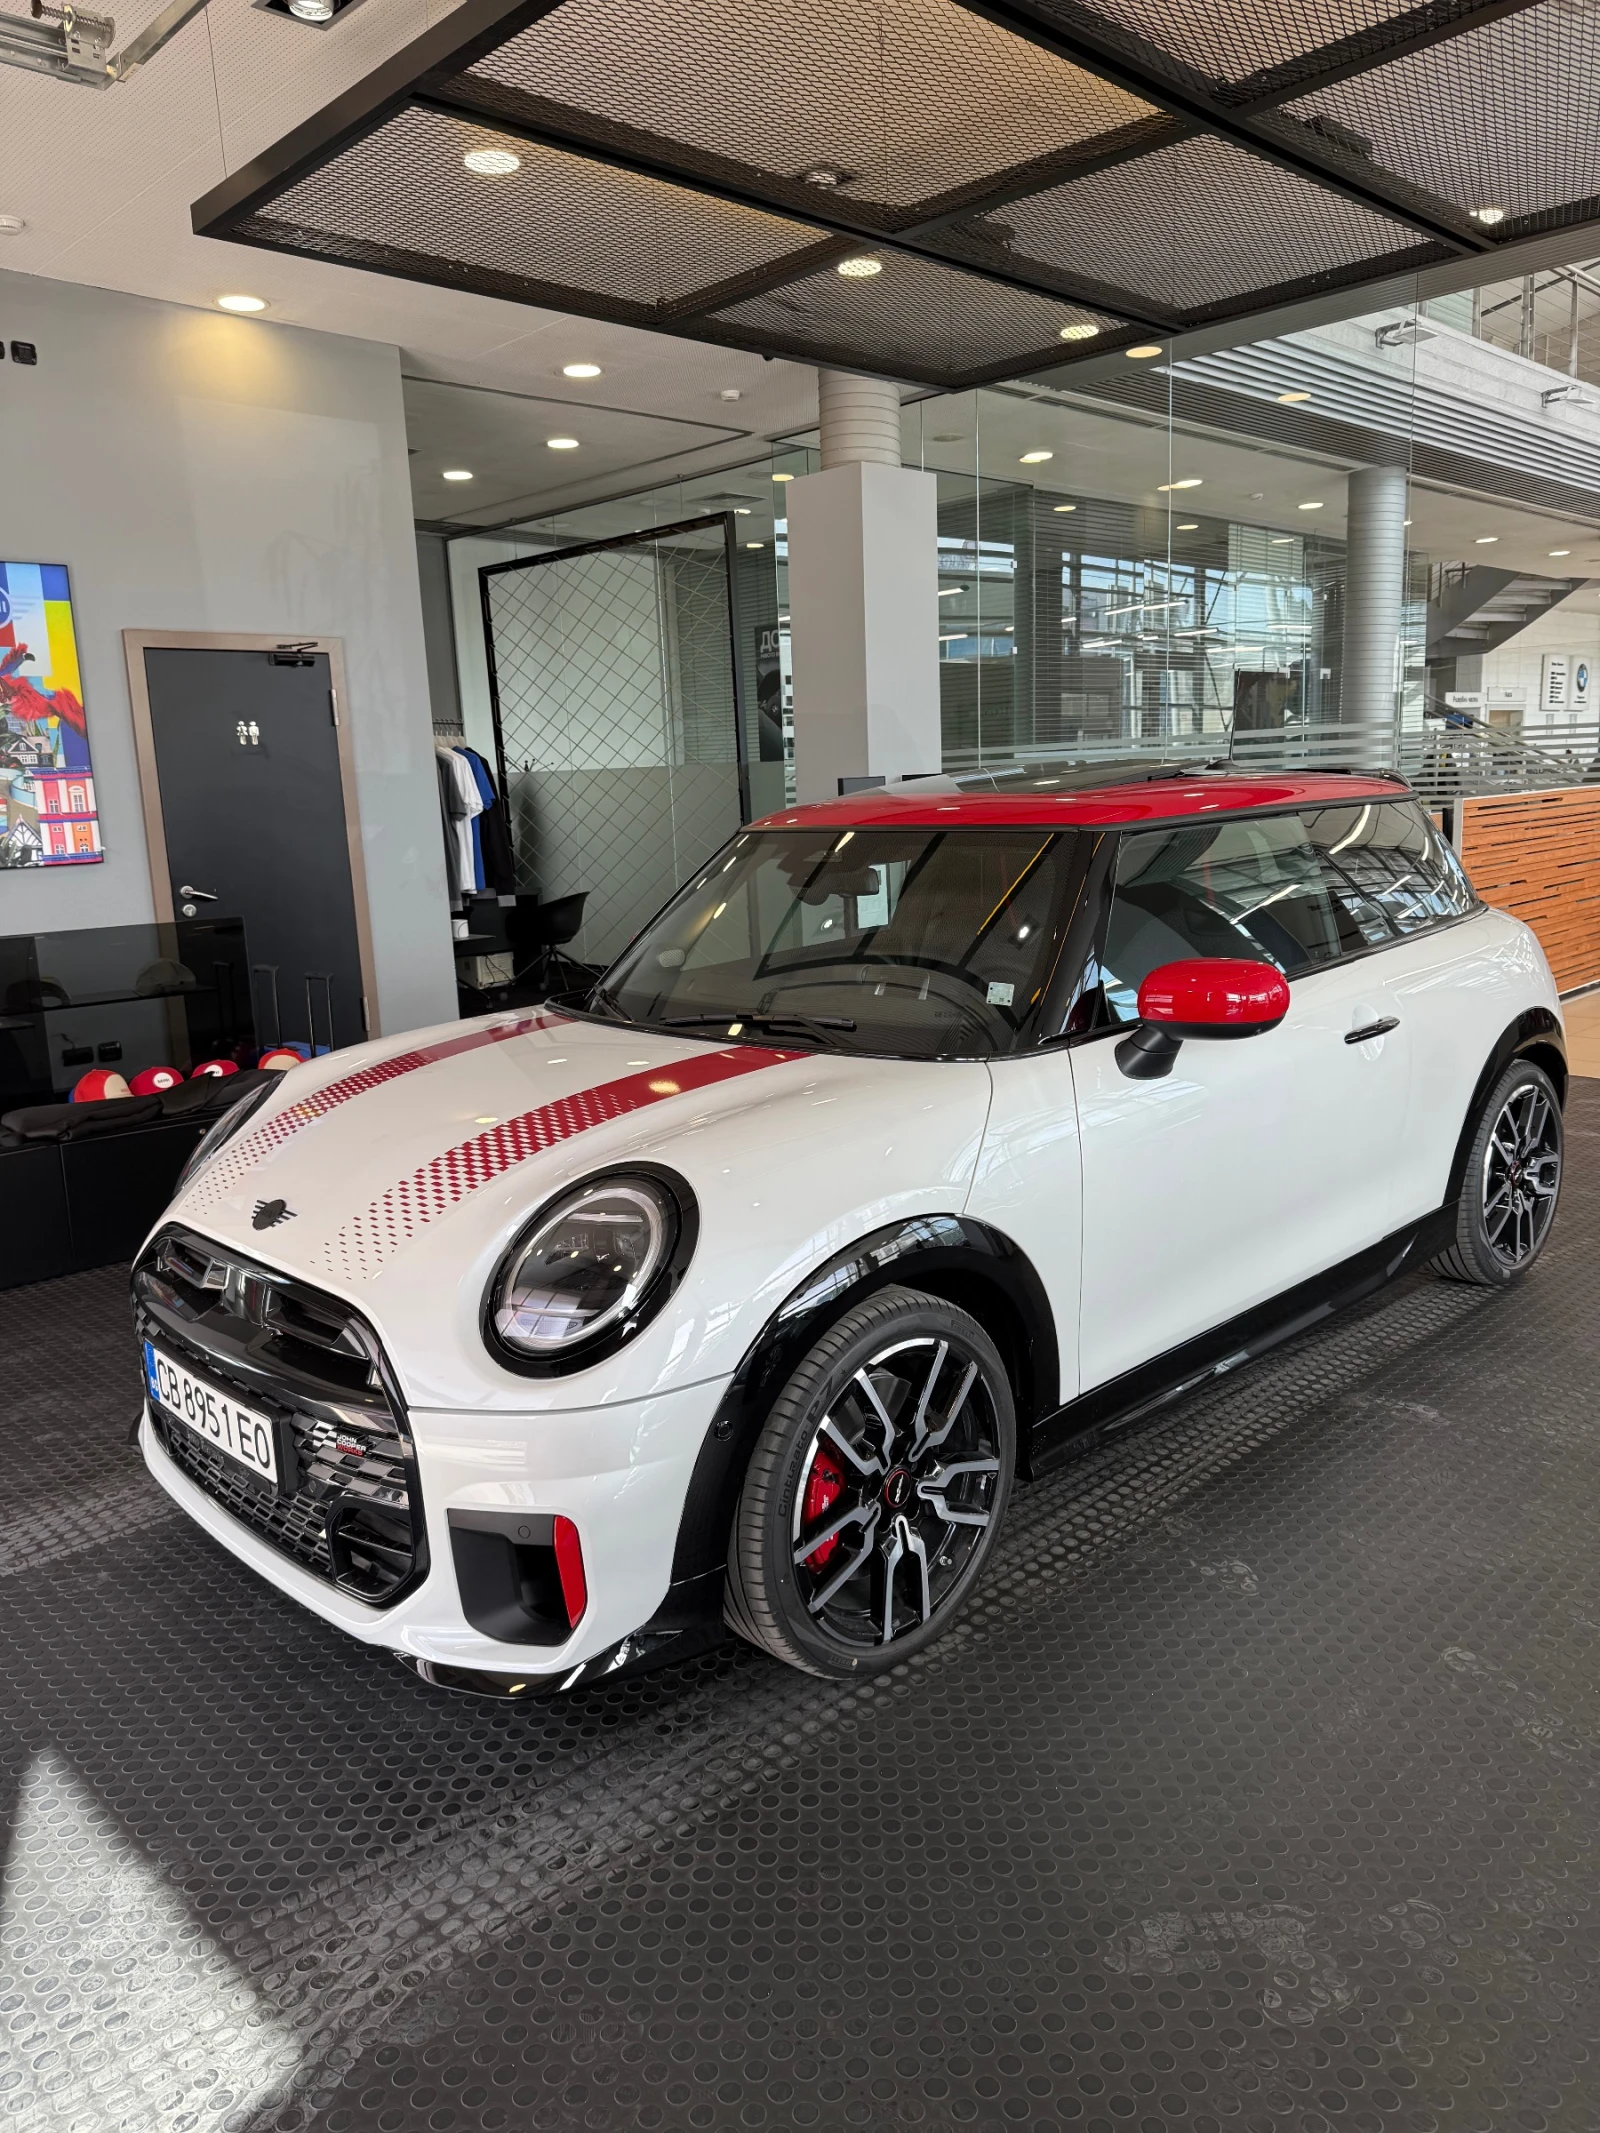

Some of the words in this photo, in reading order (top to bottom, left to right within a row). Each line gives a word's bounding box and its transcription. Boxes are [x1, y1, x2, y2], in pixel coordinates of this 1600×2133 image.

[157, 1358, 181, 1410] CB
[183, 1378, 233, 1448] 8951
[337, 1434, 357, 1444] JOHN
[337, 1438, 367, 1452] COOPER
[337, 1443, 363, 1456] WORKS
[778, 1430, 808, 1517] Cinturato
